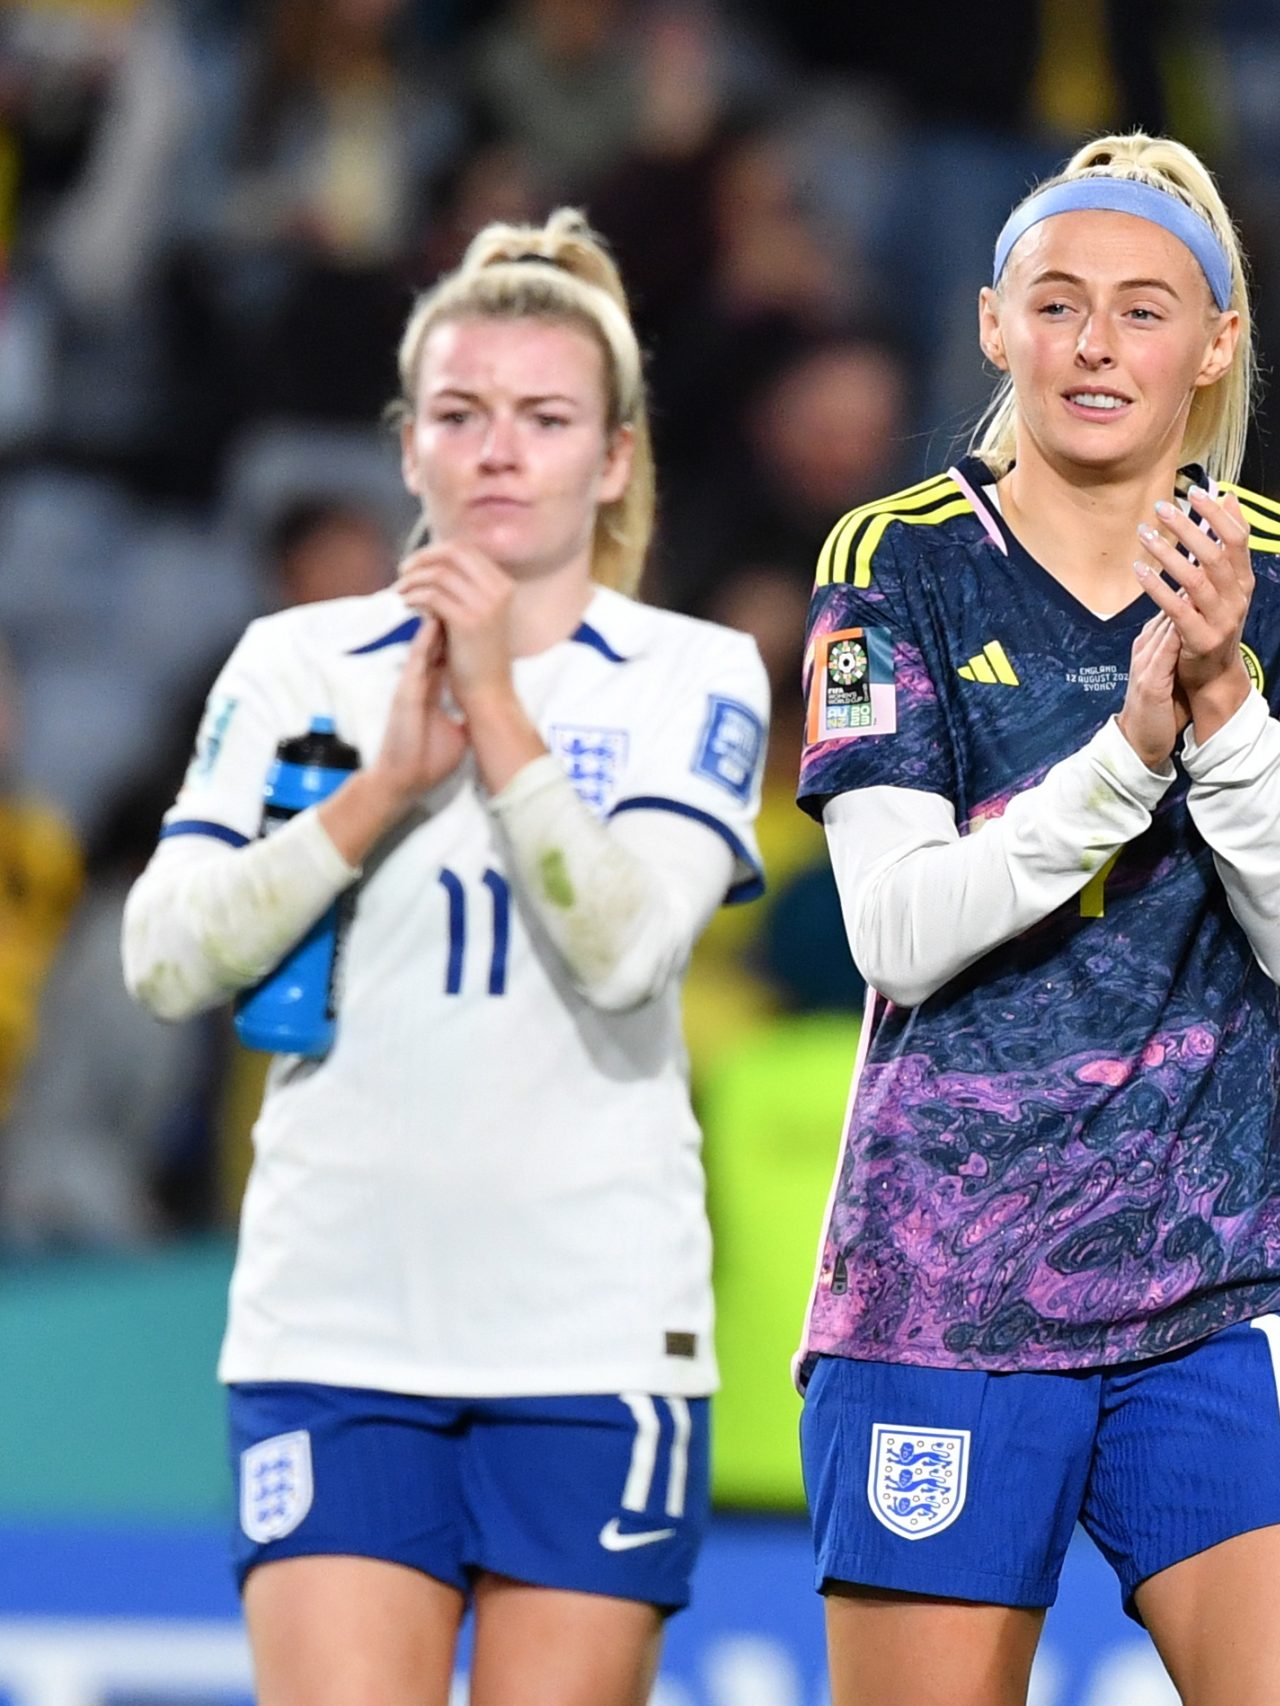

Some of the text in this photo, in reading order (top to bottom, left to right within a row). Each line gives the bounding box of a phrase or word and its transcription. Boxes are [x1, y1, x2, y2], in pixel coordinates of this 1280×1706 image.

[1079, 665, 1116, 674] ENGLAND
[1065, 673, 1129, 683] 12 AUGUST 202
[1083, 682, 1116, 691] SYDNEY
[439, 867, 509, 995] 11
[618, 1391, 691, 1518] 11
